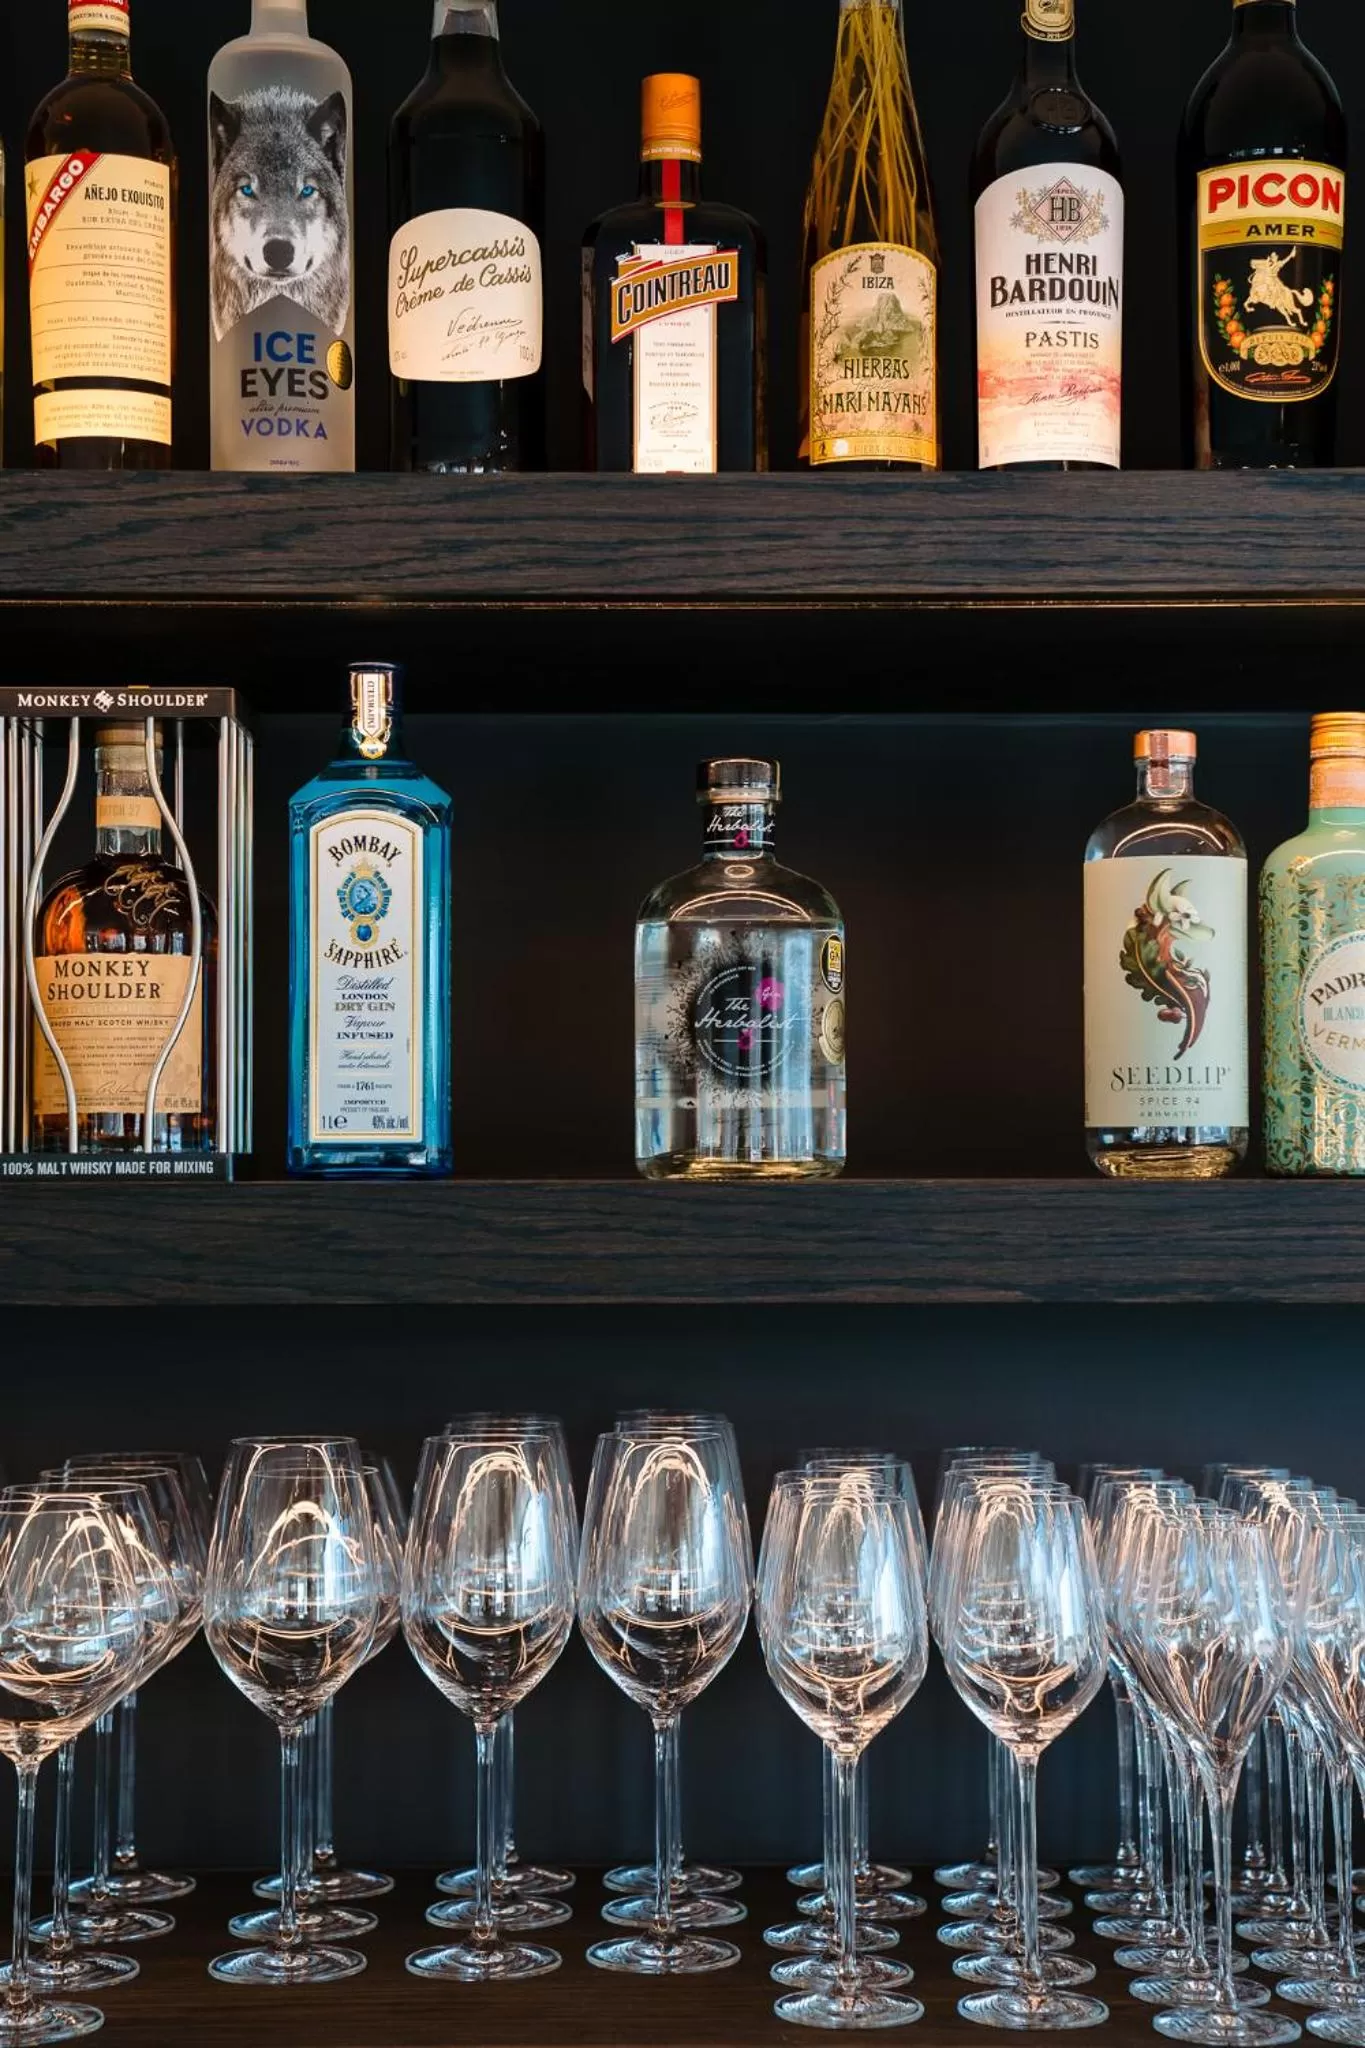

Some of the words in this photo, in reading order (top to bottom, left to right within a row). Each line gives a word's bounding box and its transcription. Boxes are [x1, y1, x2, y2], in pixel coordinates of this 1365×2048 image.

[84, 184, 118, 201] AÑEJO
[121, 188, 165, 210] EXQUISITO
[1208, 172, 1342, 214] PICON
[28, 159, 84, 260] EMBARGO
[1049, 196, 1081, 222] HB
[1246, 224, 1315, 238] AMER
[397, 236, 525, 289] Supercassis
[1025, 253, 1097, 277] HENRI
[395, 286, 445, 318] Crème
[449, 273, 475, 295] de
[479, 263, 532, 287] Cassis
[618, 262, 730, 325] COINTREAU
[862, 276, 895, 290] IBIZA
[990, 275, 1119, 311] BARDOUIN
[253, 330, 316, 364] ICE
[1025, 331, 1099, 349] PASTIS
[844, 358, 910, 379] HIERBAS
[240, 368, 330, 400] EYES
[822, 391, 862, 415] MARI
[867, 391, 927, 416] MAYANS
[241, 417, 328, 440] VODKA
[17, 693, 91, 708] MONKEY
[723, 805, 745, 817] The
[706, 815, 776, 833] Herbalist
[327, 835, 402, 867] BOMBAY
[323, 938, 405, 969] SAPPHIRE
[54, 959, 150, 978] MONKEY
[47, 982, 161, 1001] SHOULDER
[333, 974, 395, 991] Distilled
[334, 1002, 363, 1012] DRY
[367, 1002, 396, 1012] GIN
[342, 993, 389, 1001] LONDON
[725, 998, 752, 1011] The
[98, 1019, 132, 1027] SCOTCH
[136, 1019, 169, 1027] WHISKY
[694, 1006, 799, 1029] Herbalist
[336, 1031, 394, 1040] INFUSED
[356, 1081, 375, 1091] 1761
[1110, 1065, 1227, 1093] SEEDLIP
[1139, 1096, 1179, 1106] SPICE
[3, 1162, 34, 1175] 100%
[37, 1162, 67, 1175] MALT
[69, 1161, 113, 1175] WHISKY
[115, 1161, 146, 1175] MADE
[149, 1161, 172, 1174] FOR
[174, 1161, 214, 1174] MIXING
